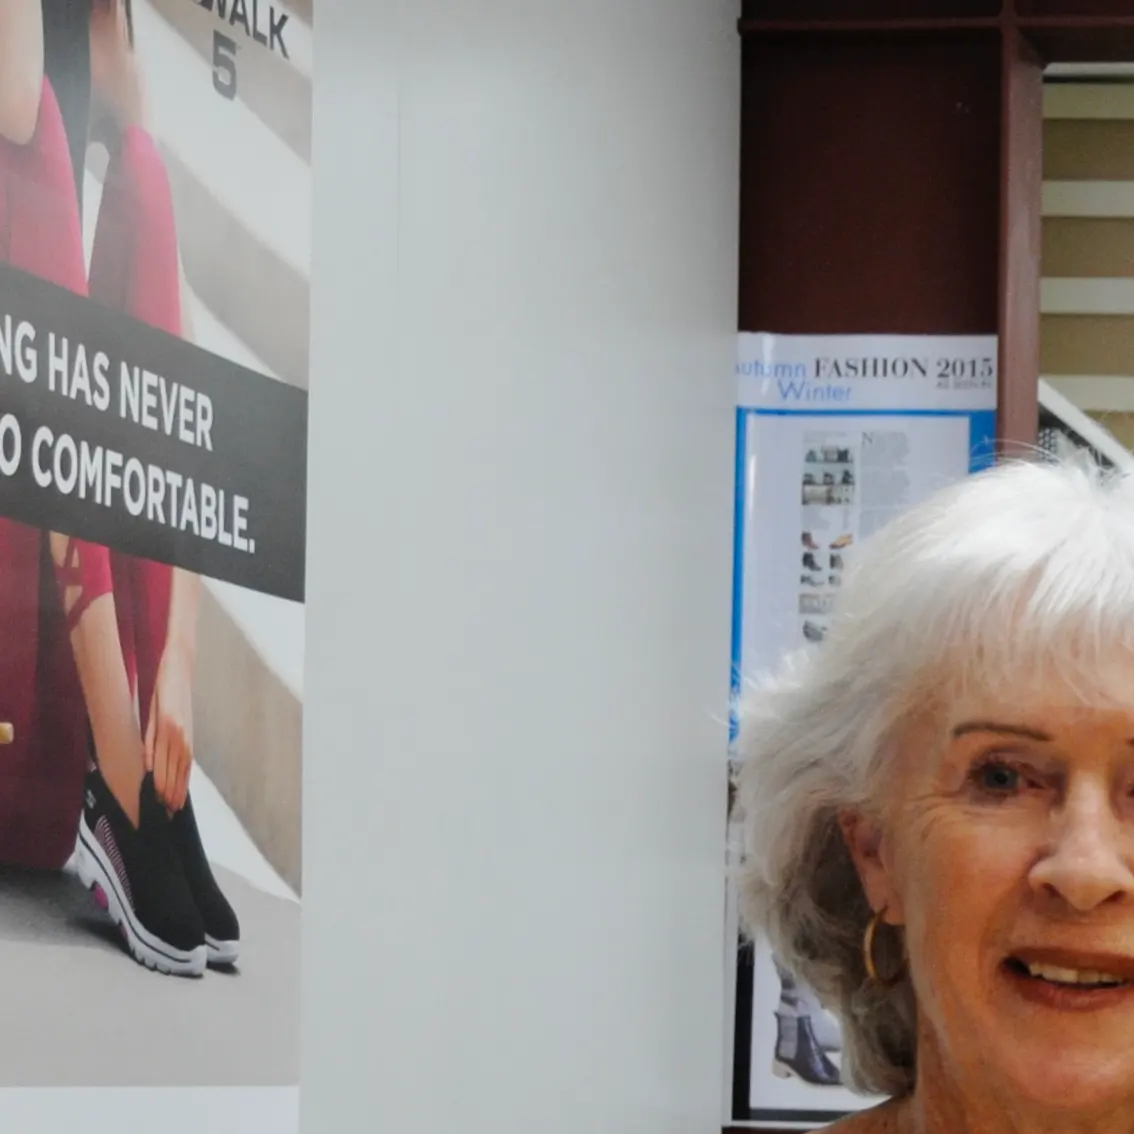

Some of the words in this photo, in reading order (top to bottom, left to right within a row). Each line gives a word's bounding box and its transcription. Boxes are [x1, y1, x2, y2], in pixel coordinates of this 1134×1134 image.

[213, 29, 238, 101] 5
[48, 331, 110, 412] HAS
[120, 361, 214, 452] NEVER
[778, 379, 852, 401] Winter
[814, 357, 928, 378] FASHION
[936, 357, 993, 378] 2015
[32, 426, 256, 554] COMFORTABLE.
